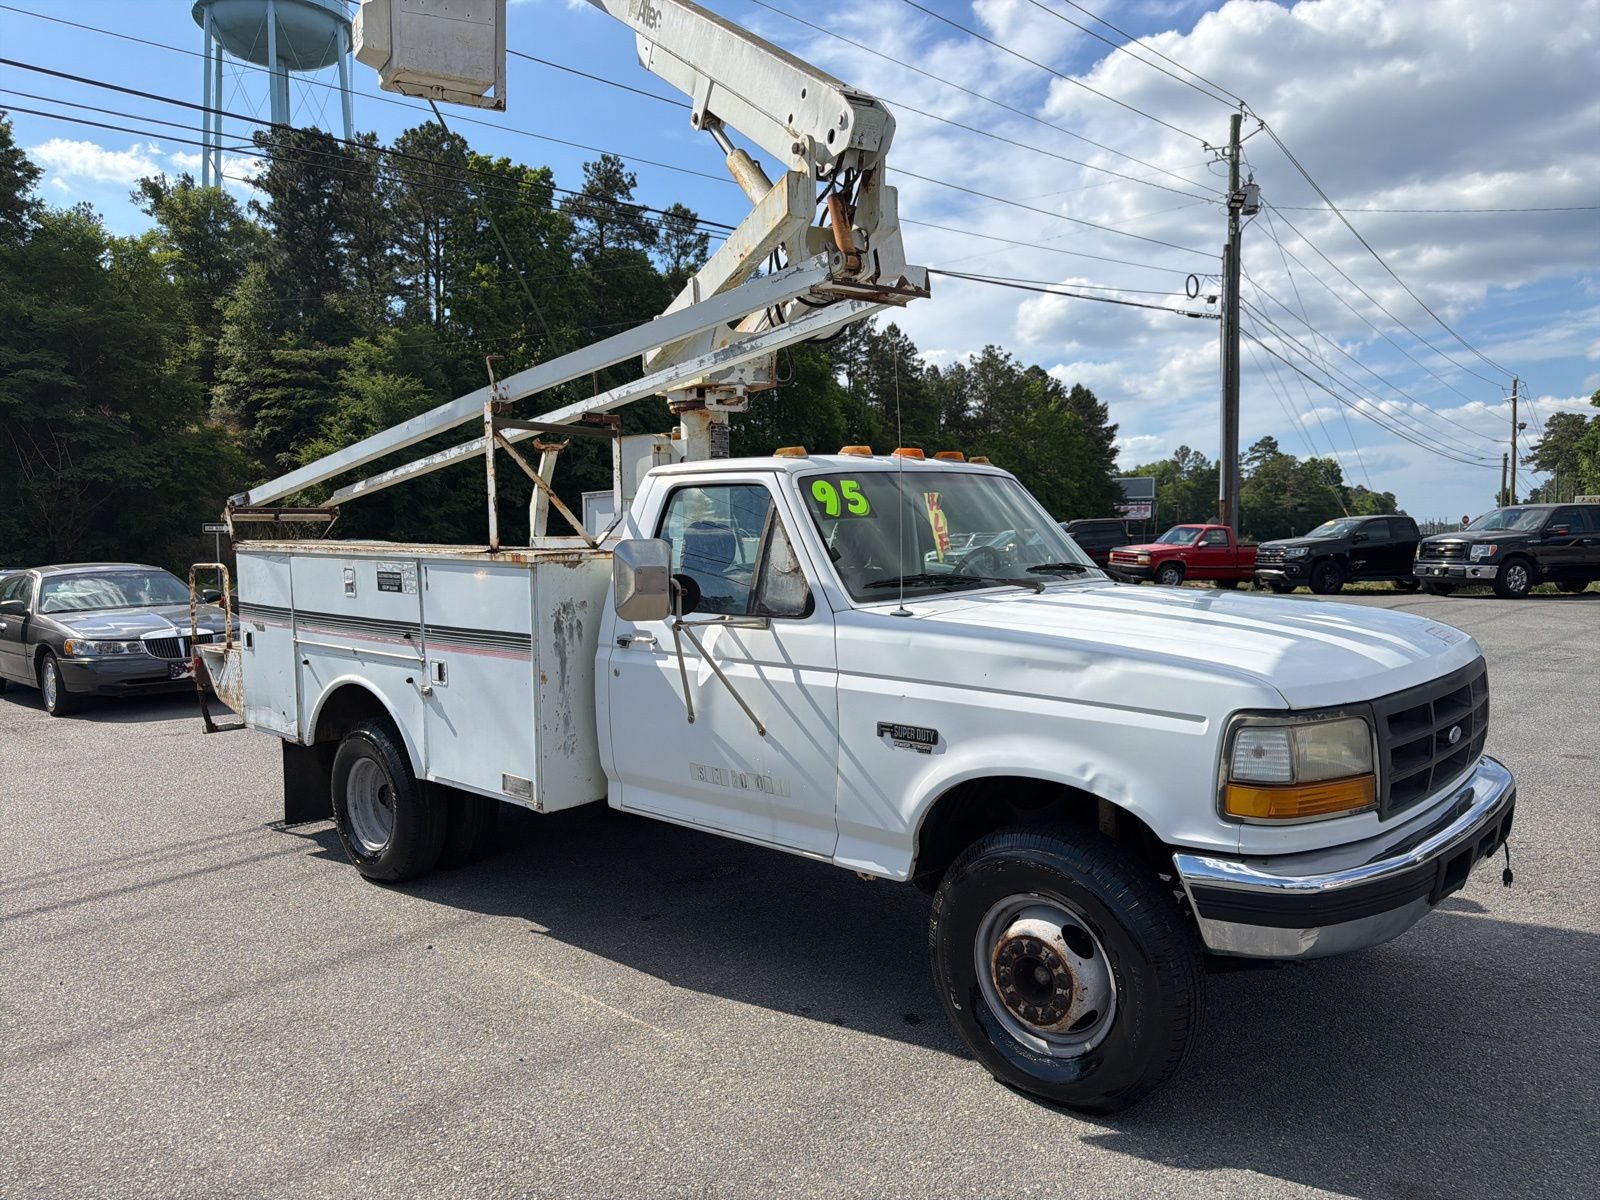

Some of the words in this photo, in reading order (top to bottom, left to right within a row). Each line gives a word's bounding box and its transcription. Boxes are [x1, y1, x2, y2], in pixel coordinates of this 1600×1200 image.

[811, 480, 870, 517] 95
[894, 725, 915, 739] SUPER
[916, 728, 935, 742] DUTY
